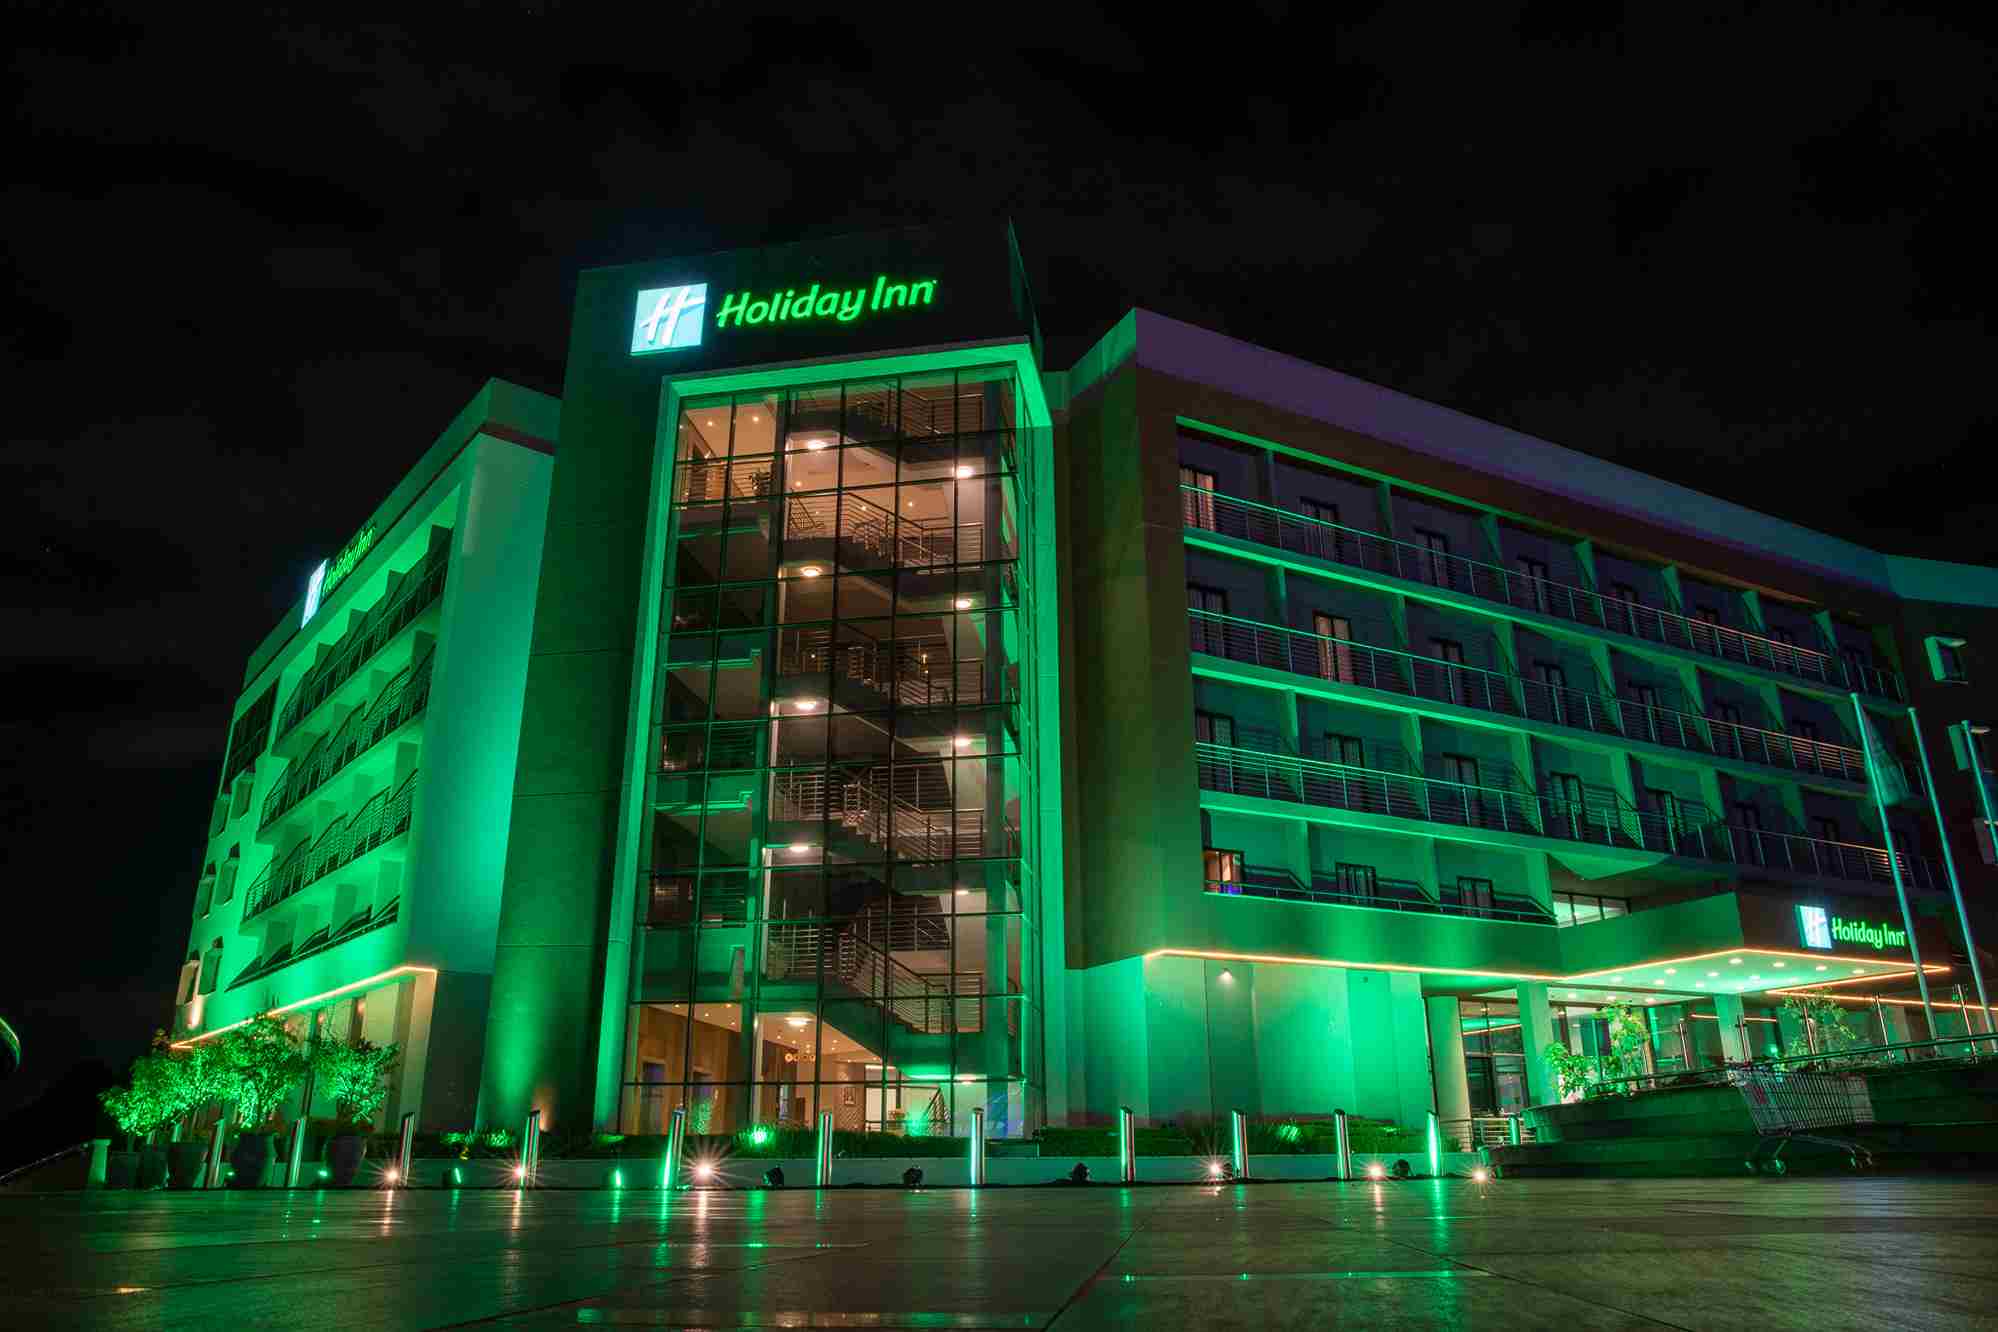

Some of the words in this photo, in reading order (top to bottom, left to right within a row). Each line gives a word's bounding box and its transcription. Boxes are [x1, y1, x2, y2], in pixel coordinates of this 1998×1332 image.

[716, 284, 866, 327] Holiday
[871, 276, 934, 310] Inn
[1832, 916, 1882, 949] Holiday
[1882, 922, 1905, 946] Inn
